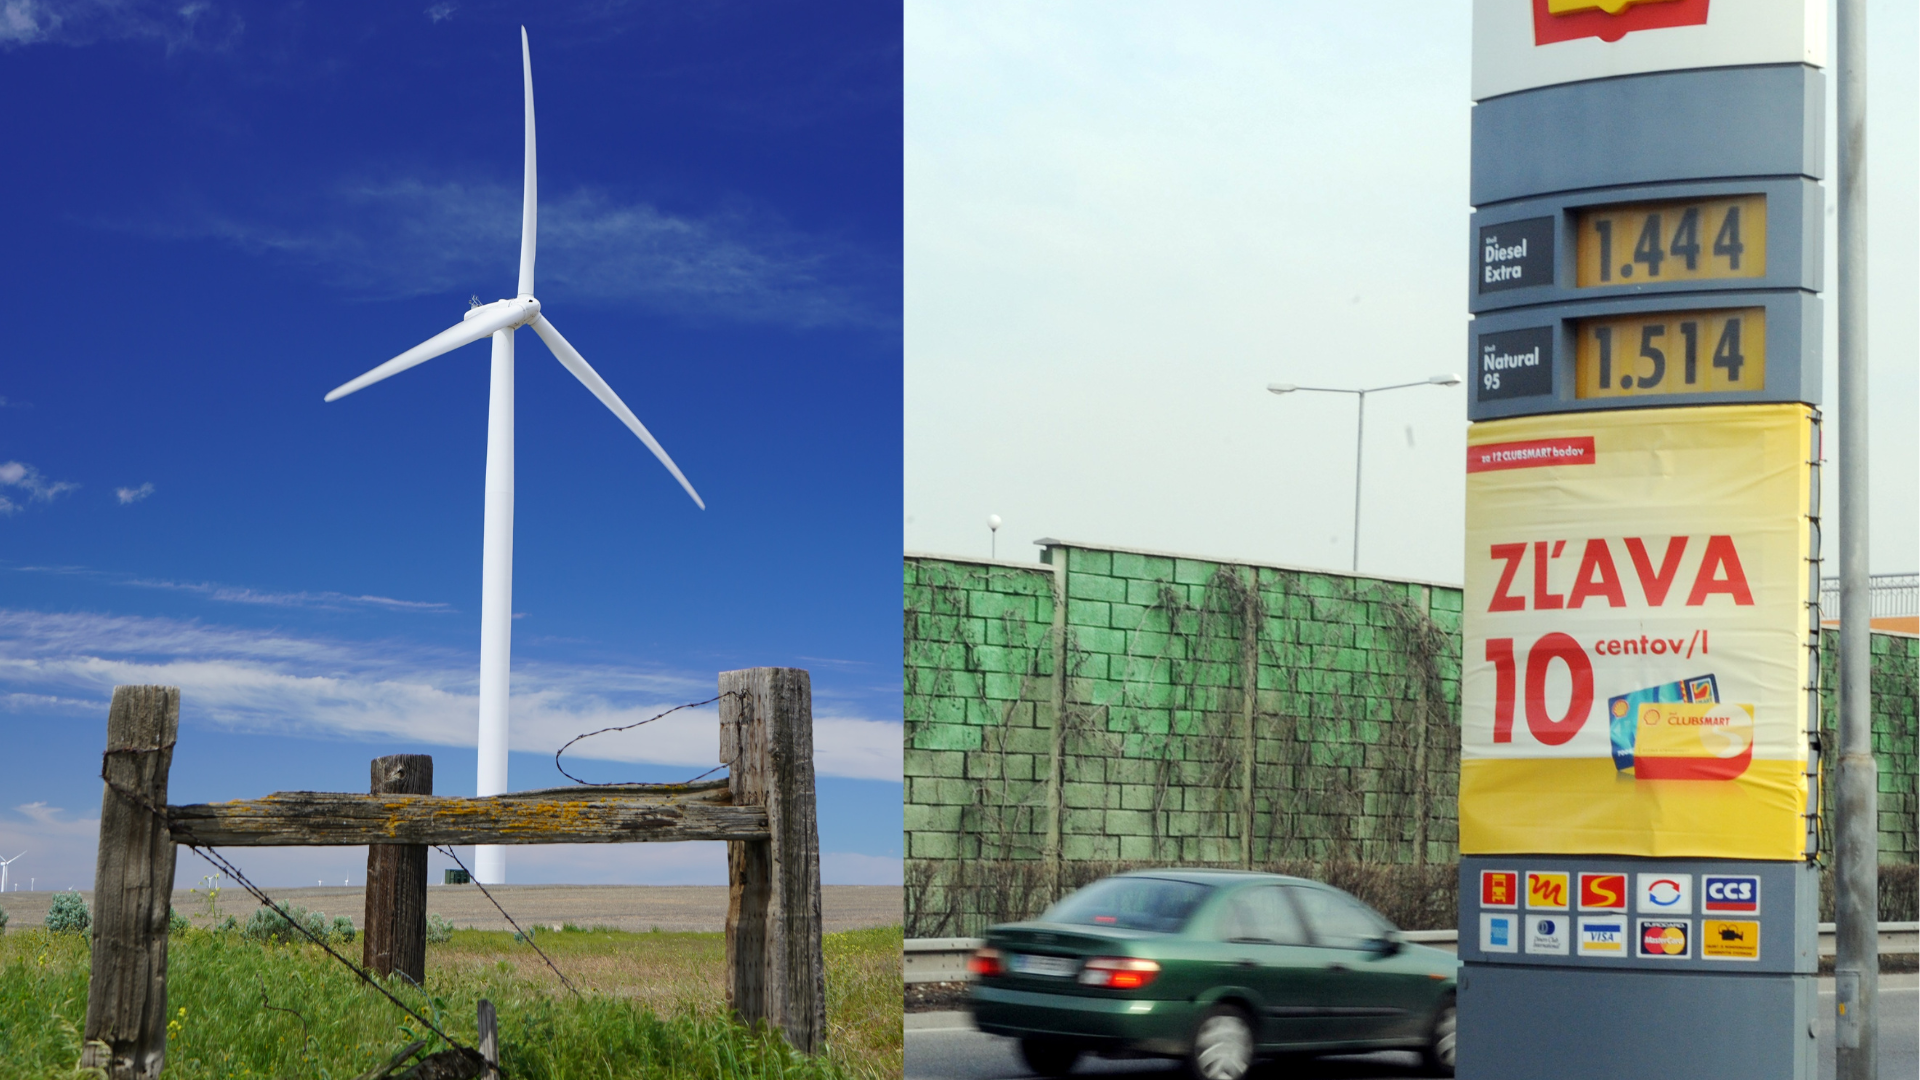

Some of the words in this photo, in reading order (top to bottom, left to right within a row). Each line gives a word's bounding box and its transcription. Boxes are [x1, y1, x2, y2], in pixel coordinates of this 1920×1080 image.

[1485, 238, 1527, 263] Diesel
[1595, 206, 1743, 282] 1.444
[1485, 265, 1522, 283] Extra
[1484, 346, 1539, 372] Natural
[1595, 318, 1744, 390] 1.514
[1484, 373, 1500, 390] 95
[1481, 454, 1491, 463] za
[1492, 451, 1502, 462] 12
[1502, 447, 1551, 461] CLUBSMART
[1552, 445, 1584, 457] bodov
[1487, 534, 1755, 613] ZĽAVA
[1485, 631, 1594, 746] 10
[1595, 629, 1708, 660] centov/l
[1668, 716, 1730, 726] CLUBSMART
[1708, 882, 1752, 899] CCS
[1591, 932, 1614, 942] VISA
[1644, 936, 1684, 945] MasterCard
